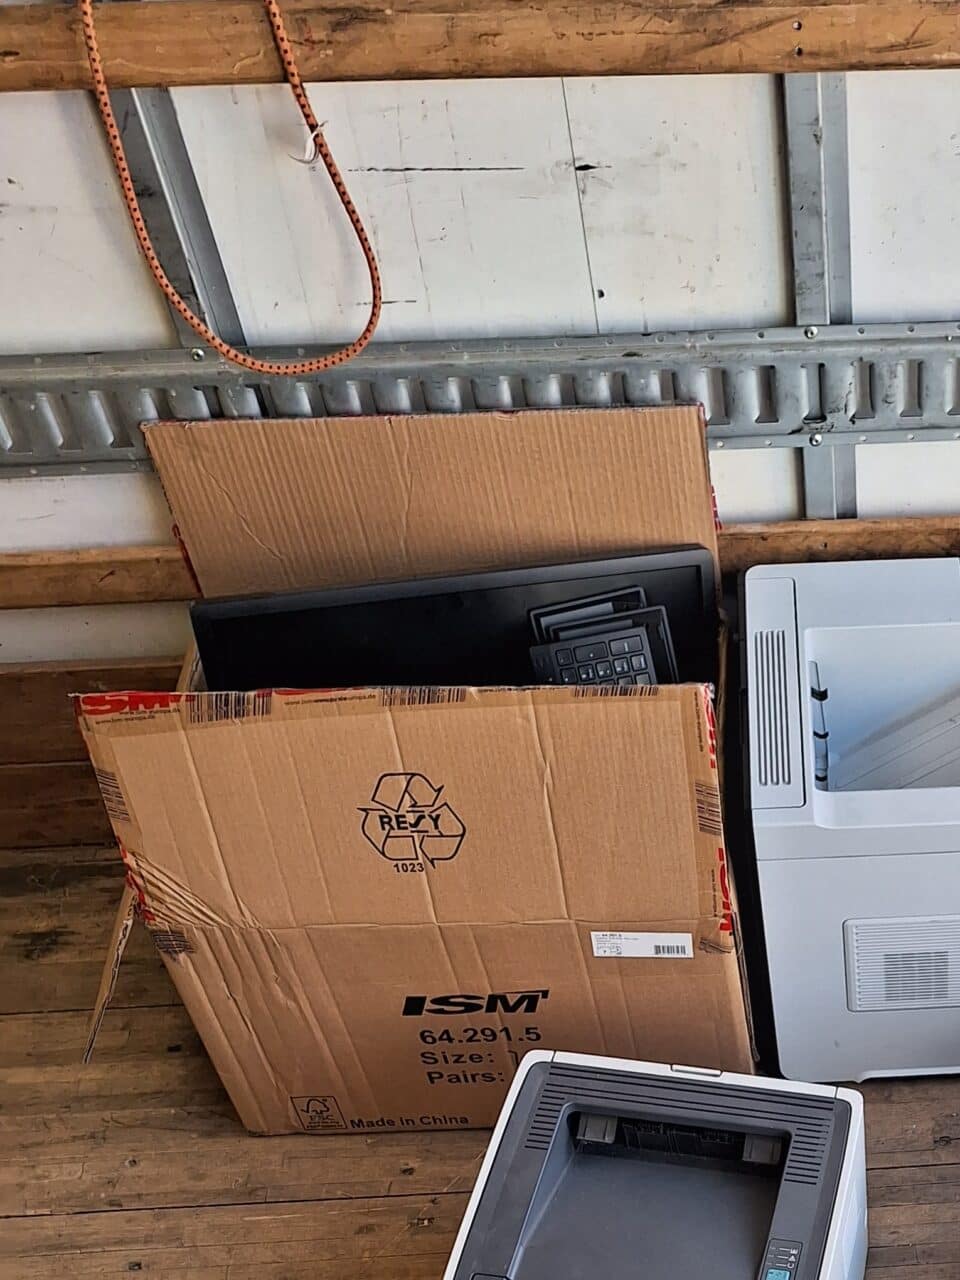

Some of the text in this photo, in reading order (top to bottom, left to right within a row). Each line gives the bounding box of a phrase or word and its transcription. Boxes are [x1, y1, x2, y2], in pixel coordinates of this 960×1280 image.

[378, 813, 442, 831] RESY
[393, 863, 425, 873] 1023
[402, 989, 550, 1016] ISM
[419, 1027, 542, 1045] 64.291.5
[420, 1051, 495, 1065] Size:
[426, 1071, 505, 1085] Pairs:
[350, 1118, 396, 1129] Made
[420, 1114, 470, 1126] China
